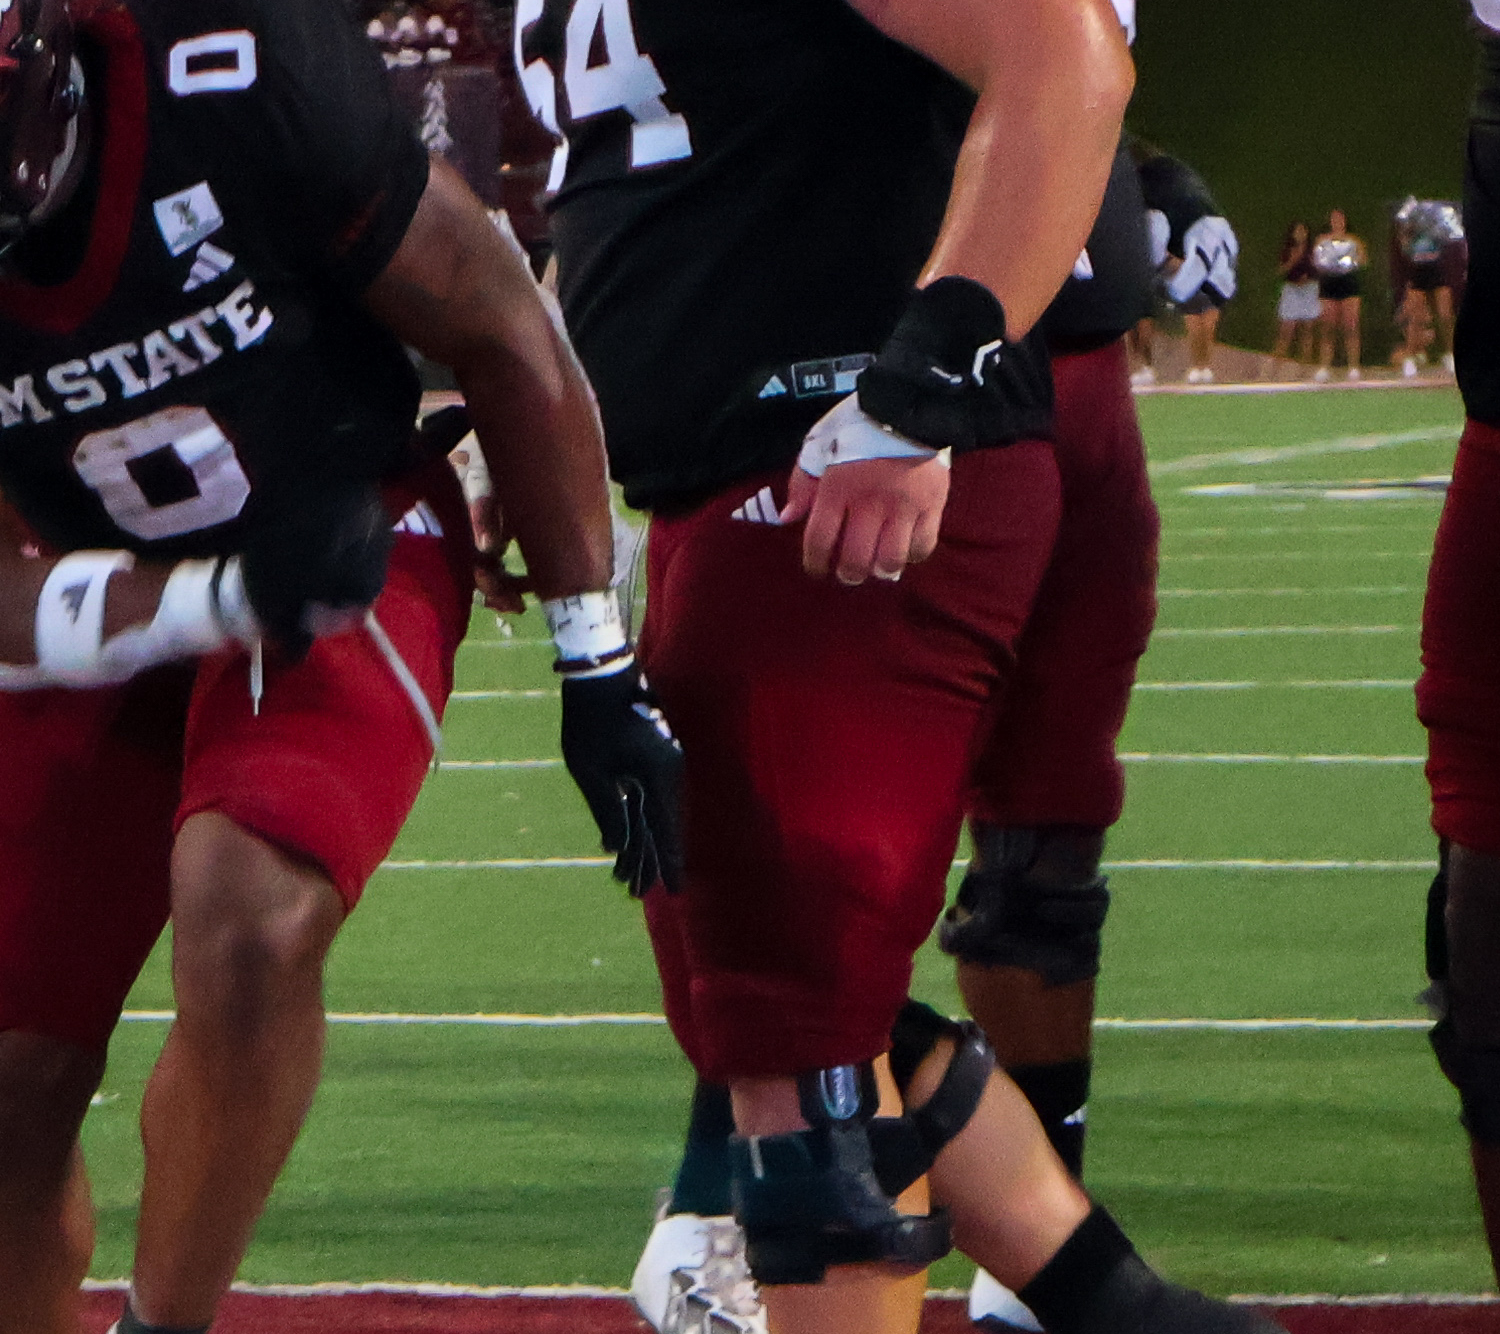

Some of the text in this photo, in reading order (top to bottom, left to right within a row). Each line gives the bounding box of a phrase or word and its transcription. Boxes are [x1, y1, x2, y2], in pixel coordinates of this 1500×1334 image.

[168, 28, 258, 97] 0
[47, 278, 275, 413] STATE
[72, 405, 251, 543] 0
